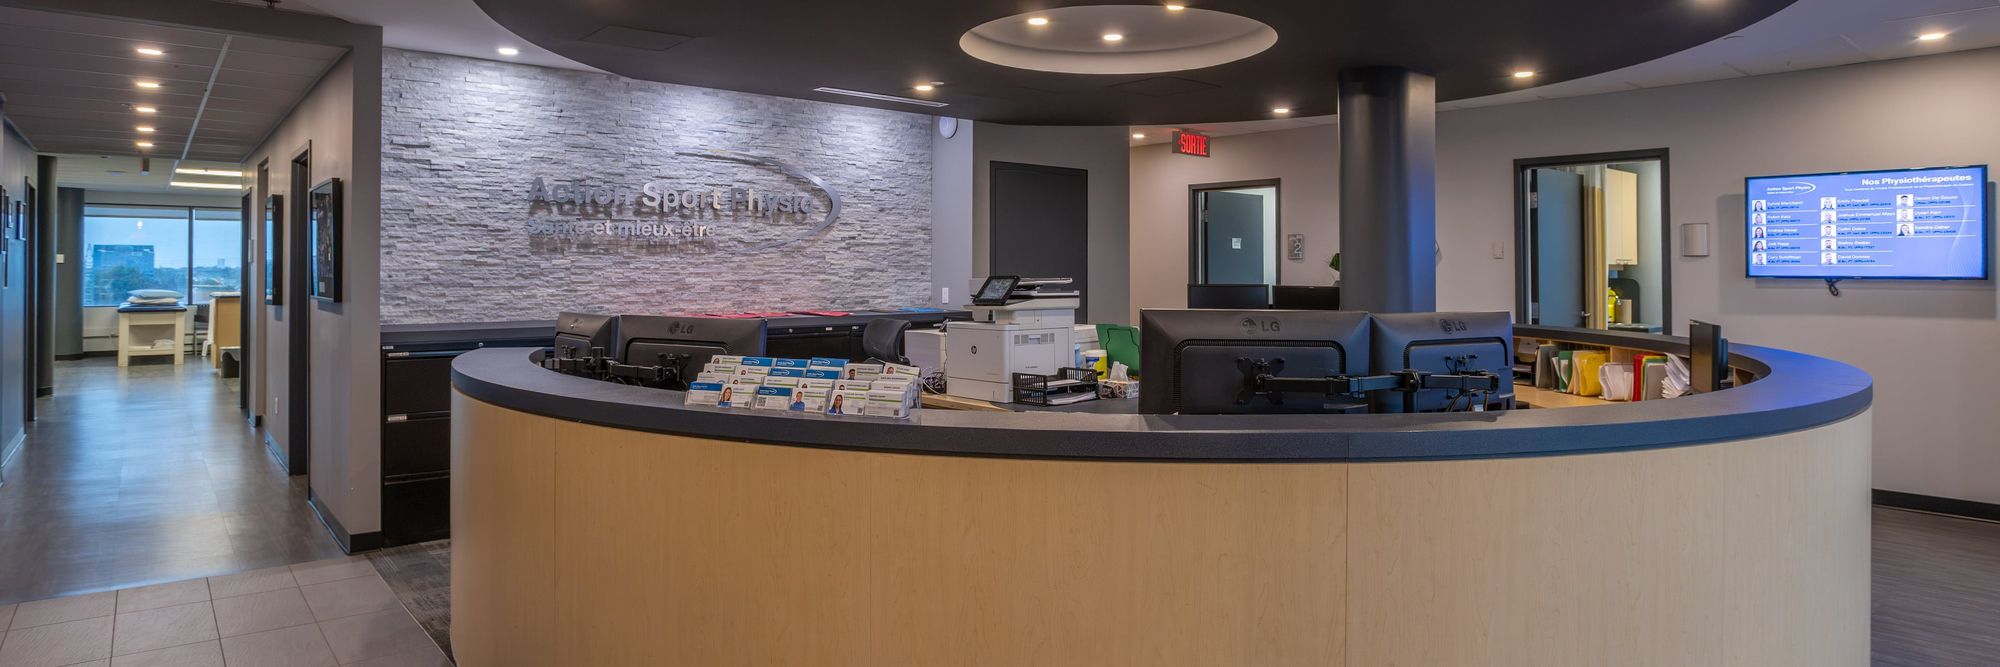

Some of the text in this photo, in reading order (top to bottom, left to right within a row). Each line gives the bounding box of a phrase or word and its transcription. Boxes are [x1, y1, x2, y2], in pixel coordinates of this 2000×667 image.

[1180, 133, 1207, 156] SORTIE
[1882, 174, 1972, 186] Physiothérapeutes
[526, 177, 814, 216] Action Sport Physio
[594, 220, 612, 235] et
[618, 220, 716, 237] mieux-être
[1294, 242, 1302, 253] 2
[680, 325, 694, 334] LG
[1262, 322, 1280, 332] LG
[1454, 321, 1467, 331] LG
